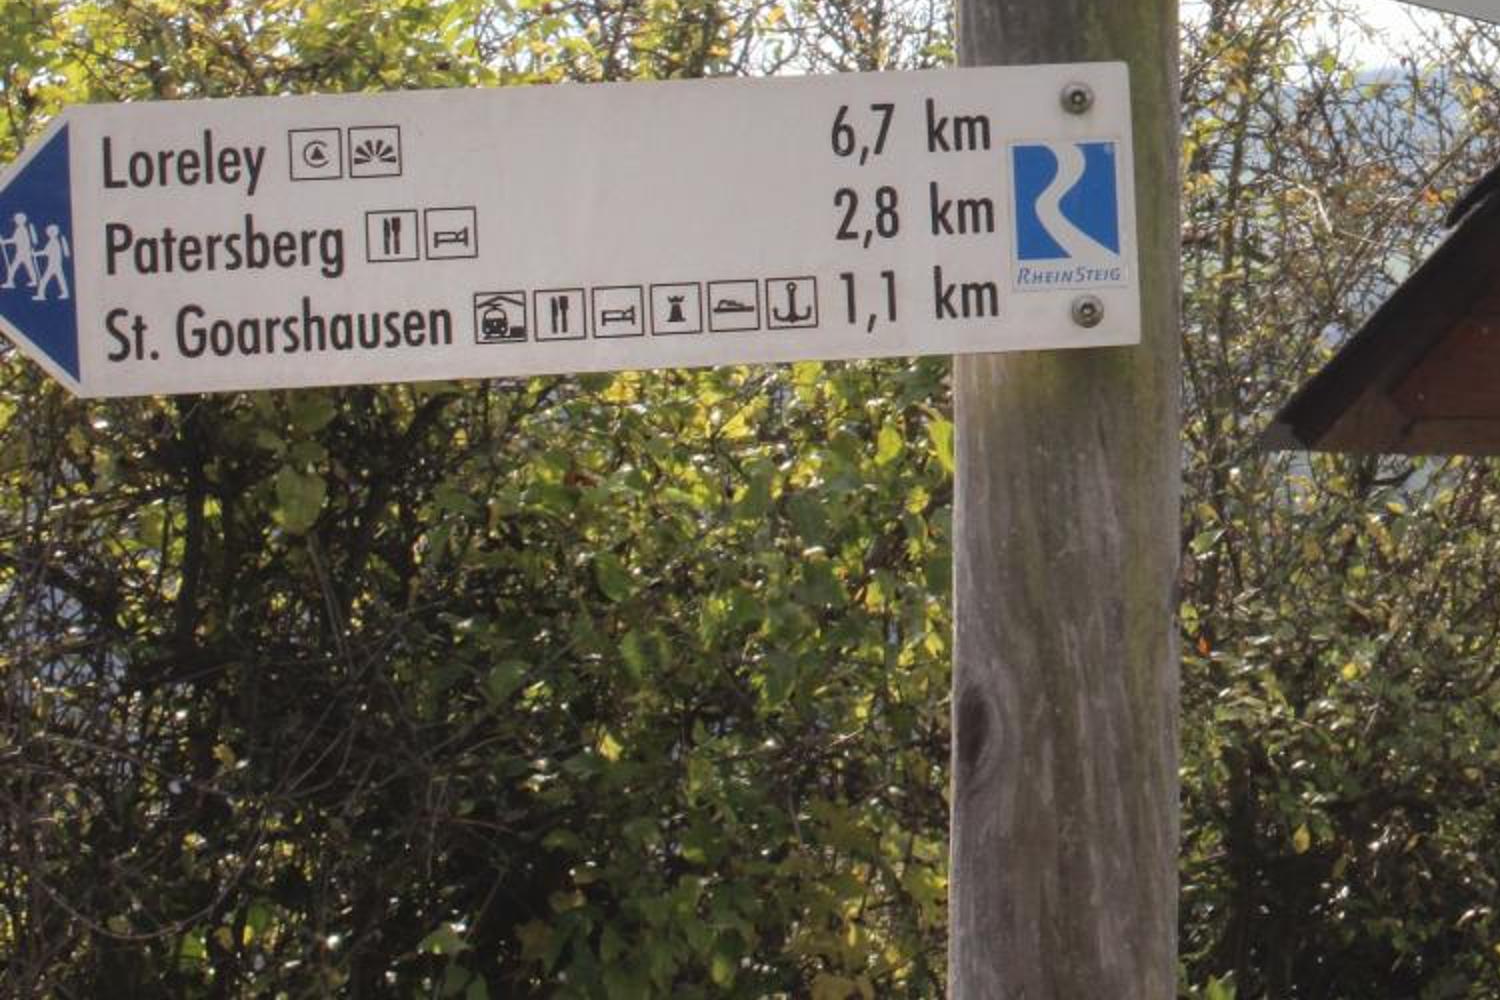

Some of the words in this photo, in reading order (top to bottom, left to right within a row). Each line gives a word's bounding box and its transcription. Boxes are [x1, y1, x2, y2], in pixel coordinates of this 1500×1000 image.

[102, 129, 266, 196] Loreley
[832, 103, 894, 166] 6,7
[926, 99, 990, 153] km
[106, 214, 345, 278] Patersberg
[834, 188, 899, 249] 2,8
[930, 182, 994, 235] km
[107, 308, 160, 362] St.
[177, 297, 452, 358] Goarshausen
[840, 271, 897, 332] 1,1
[934, 265, 998, 320] km
